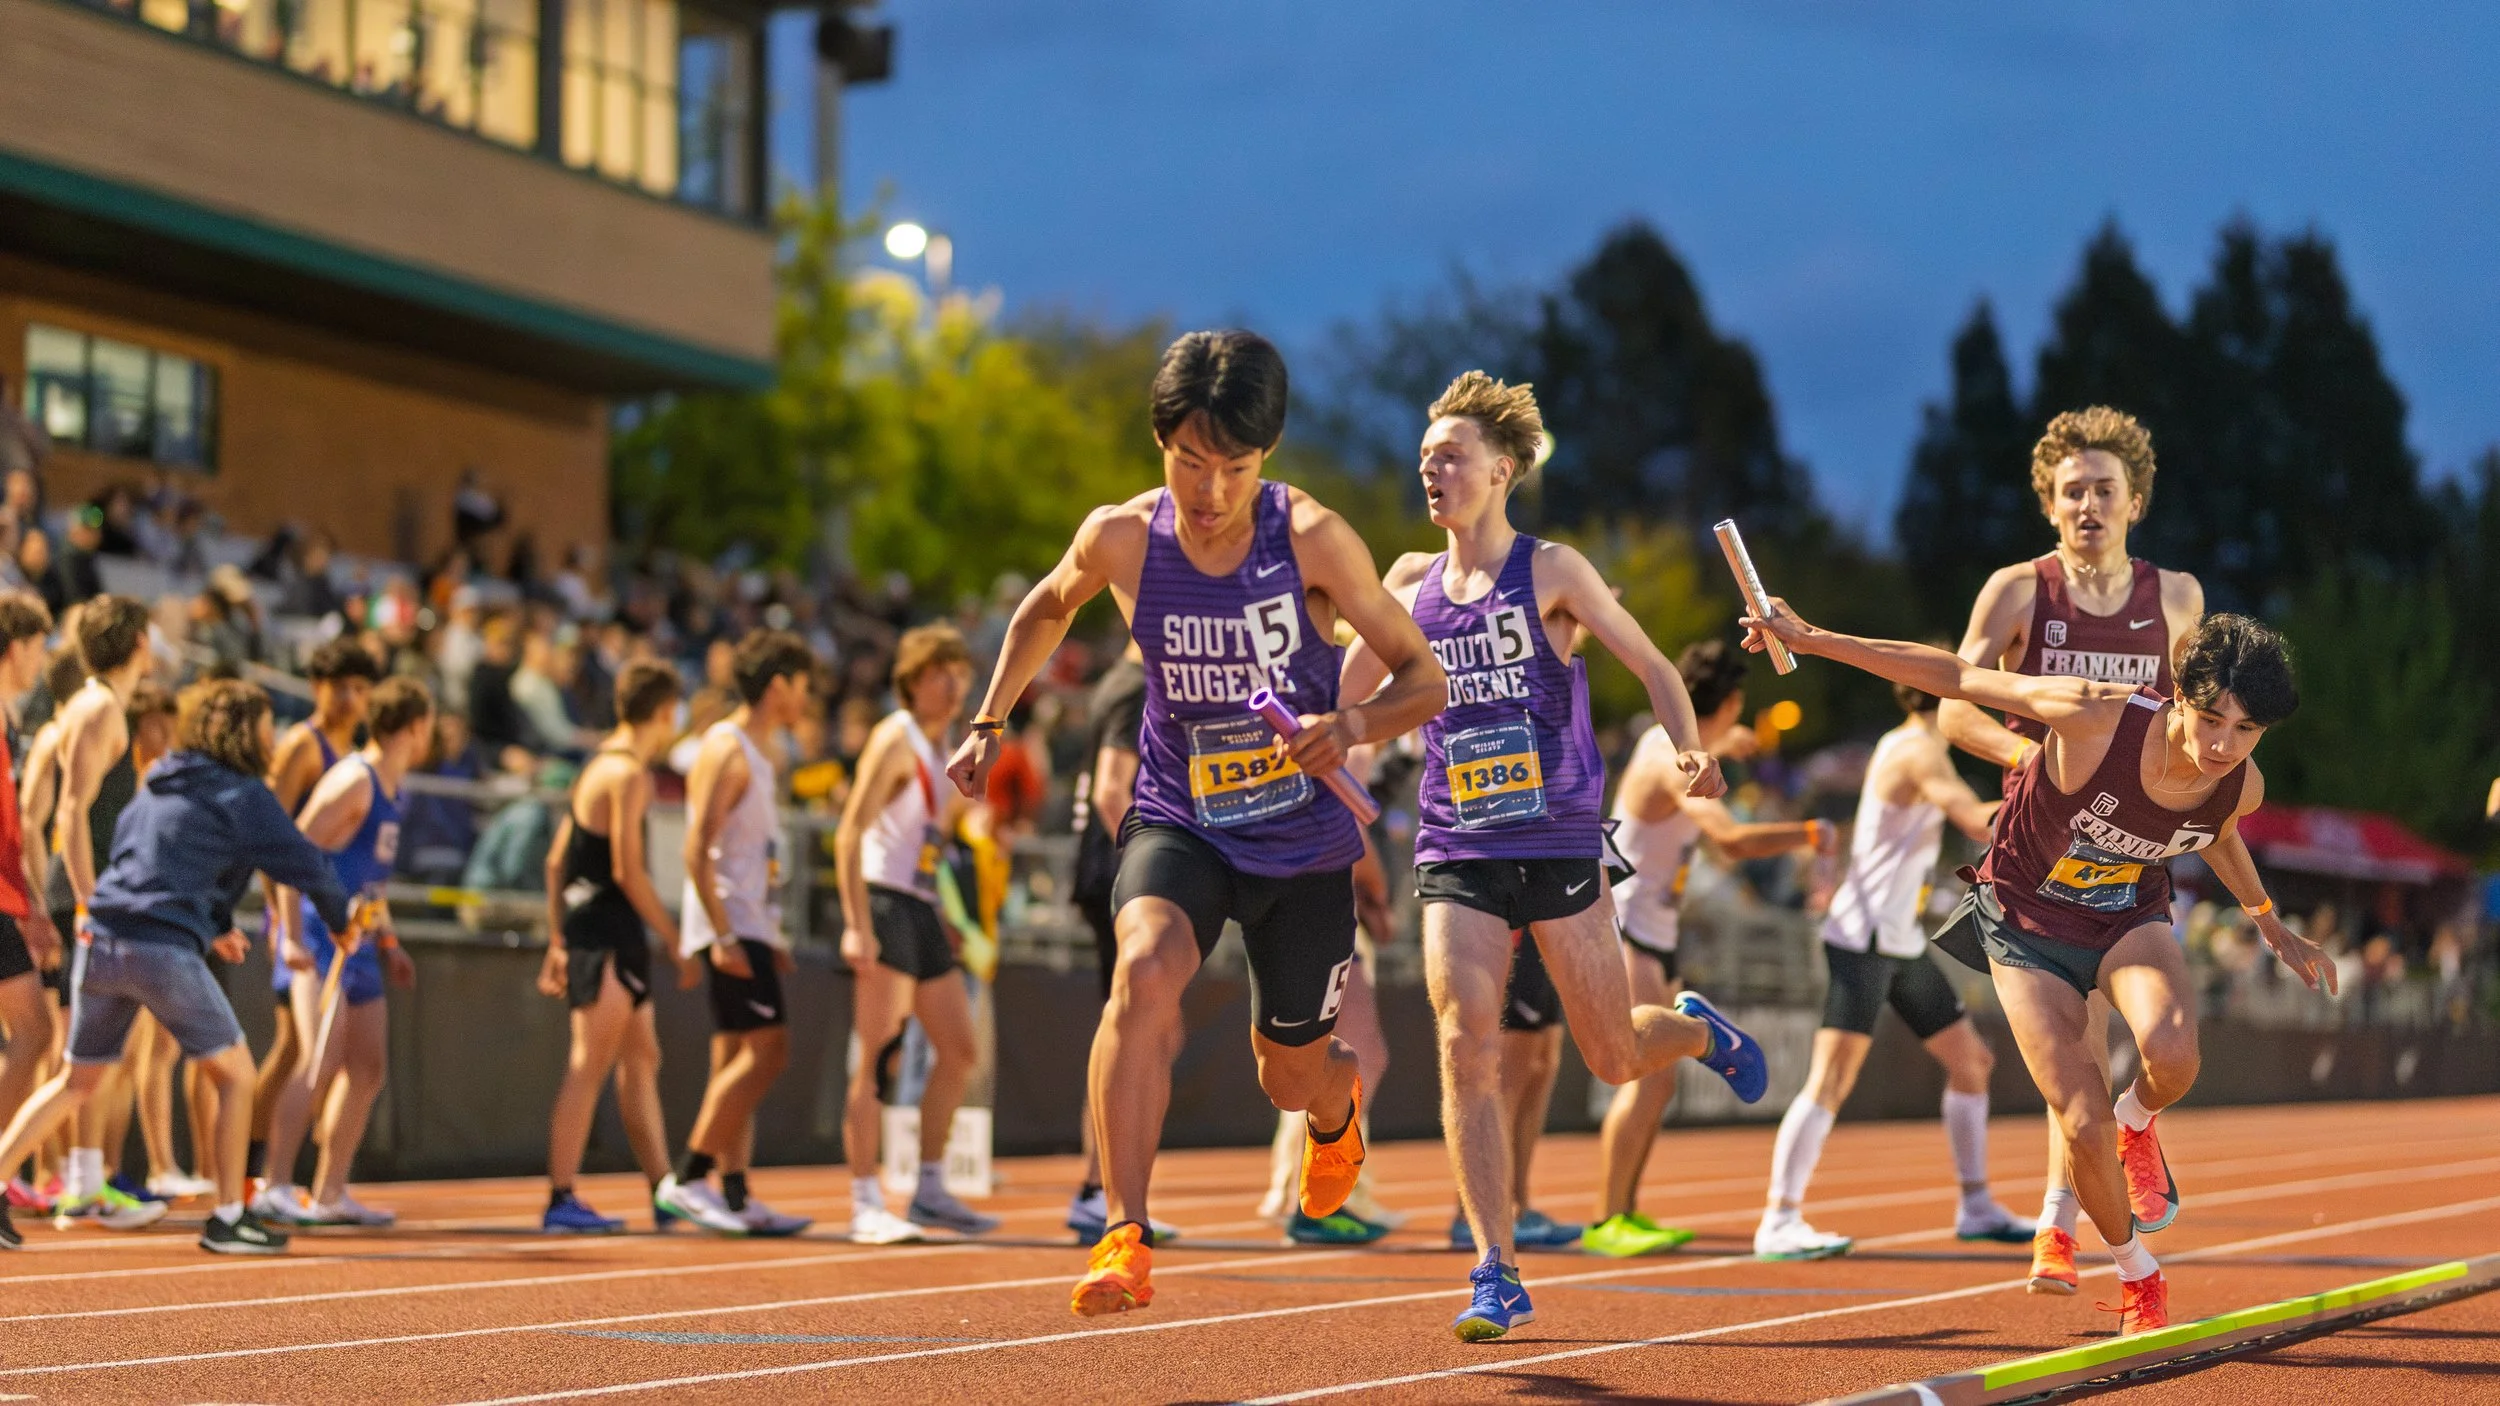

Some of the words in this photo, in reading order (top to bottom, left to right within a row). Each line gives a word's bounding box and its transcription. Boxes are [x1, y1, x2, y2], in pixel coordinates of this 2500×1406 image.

[1163, 614, 1250, 658] SOUT
[1257, 601, 1291, 660] 5
[1496, 611, 1523, 660] 5
[1429, 633, 1493, 671] SOUT
[2041, 650, 2160, 679] FRANKLIN
[1446, 665, 1530, 708] UGENE
[1208, 751, 1288, 785] 1387
[1461, 762, 1529, 792] 1386
